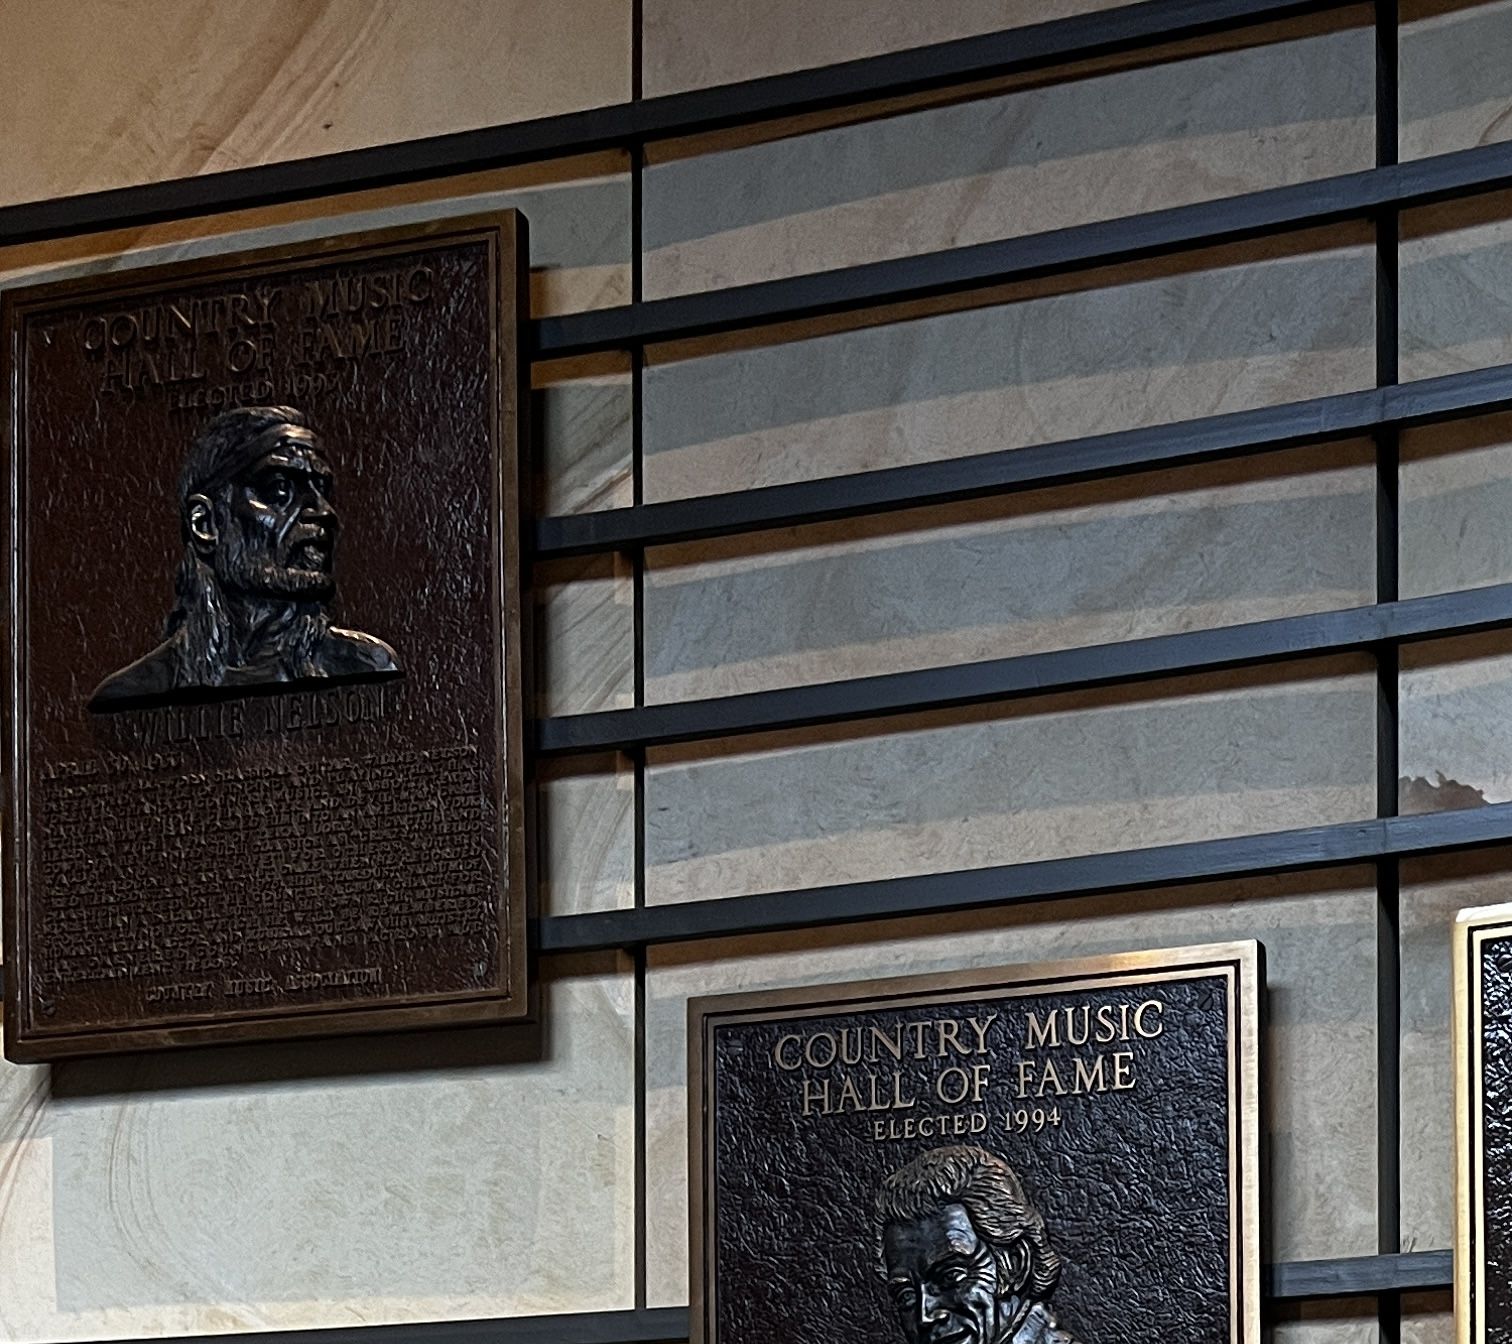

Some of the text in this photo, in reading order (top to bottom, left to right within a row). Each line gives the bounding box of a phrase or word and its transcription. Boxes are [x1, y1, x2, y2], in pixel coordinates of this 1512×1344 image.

[82, 266, 433, 353] COUNTRY MUSIC
[101, 307, 411, 392] HALL OF FAME
[774, 1000, 1165, 1072] COUNTRY MUSIC
[800, 1052, 1137, 1118] HALL OF FAME
[873, 1107, 1062, 1141] ELECTED 1994
